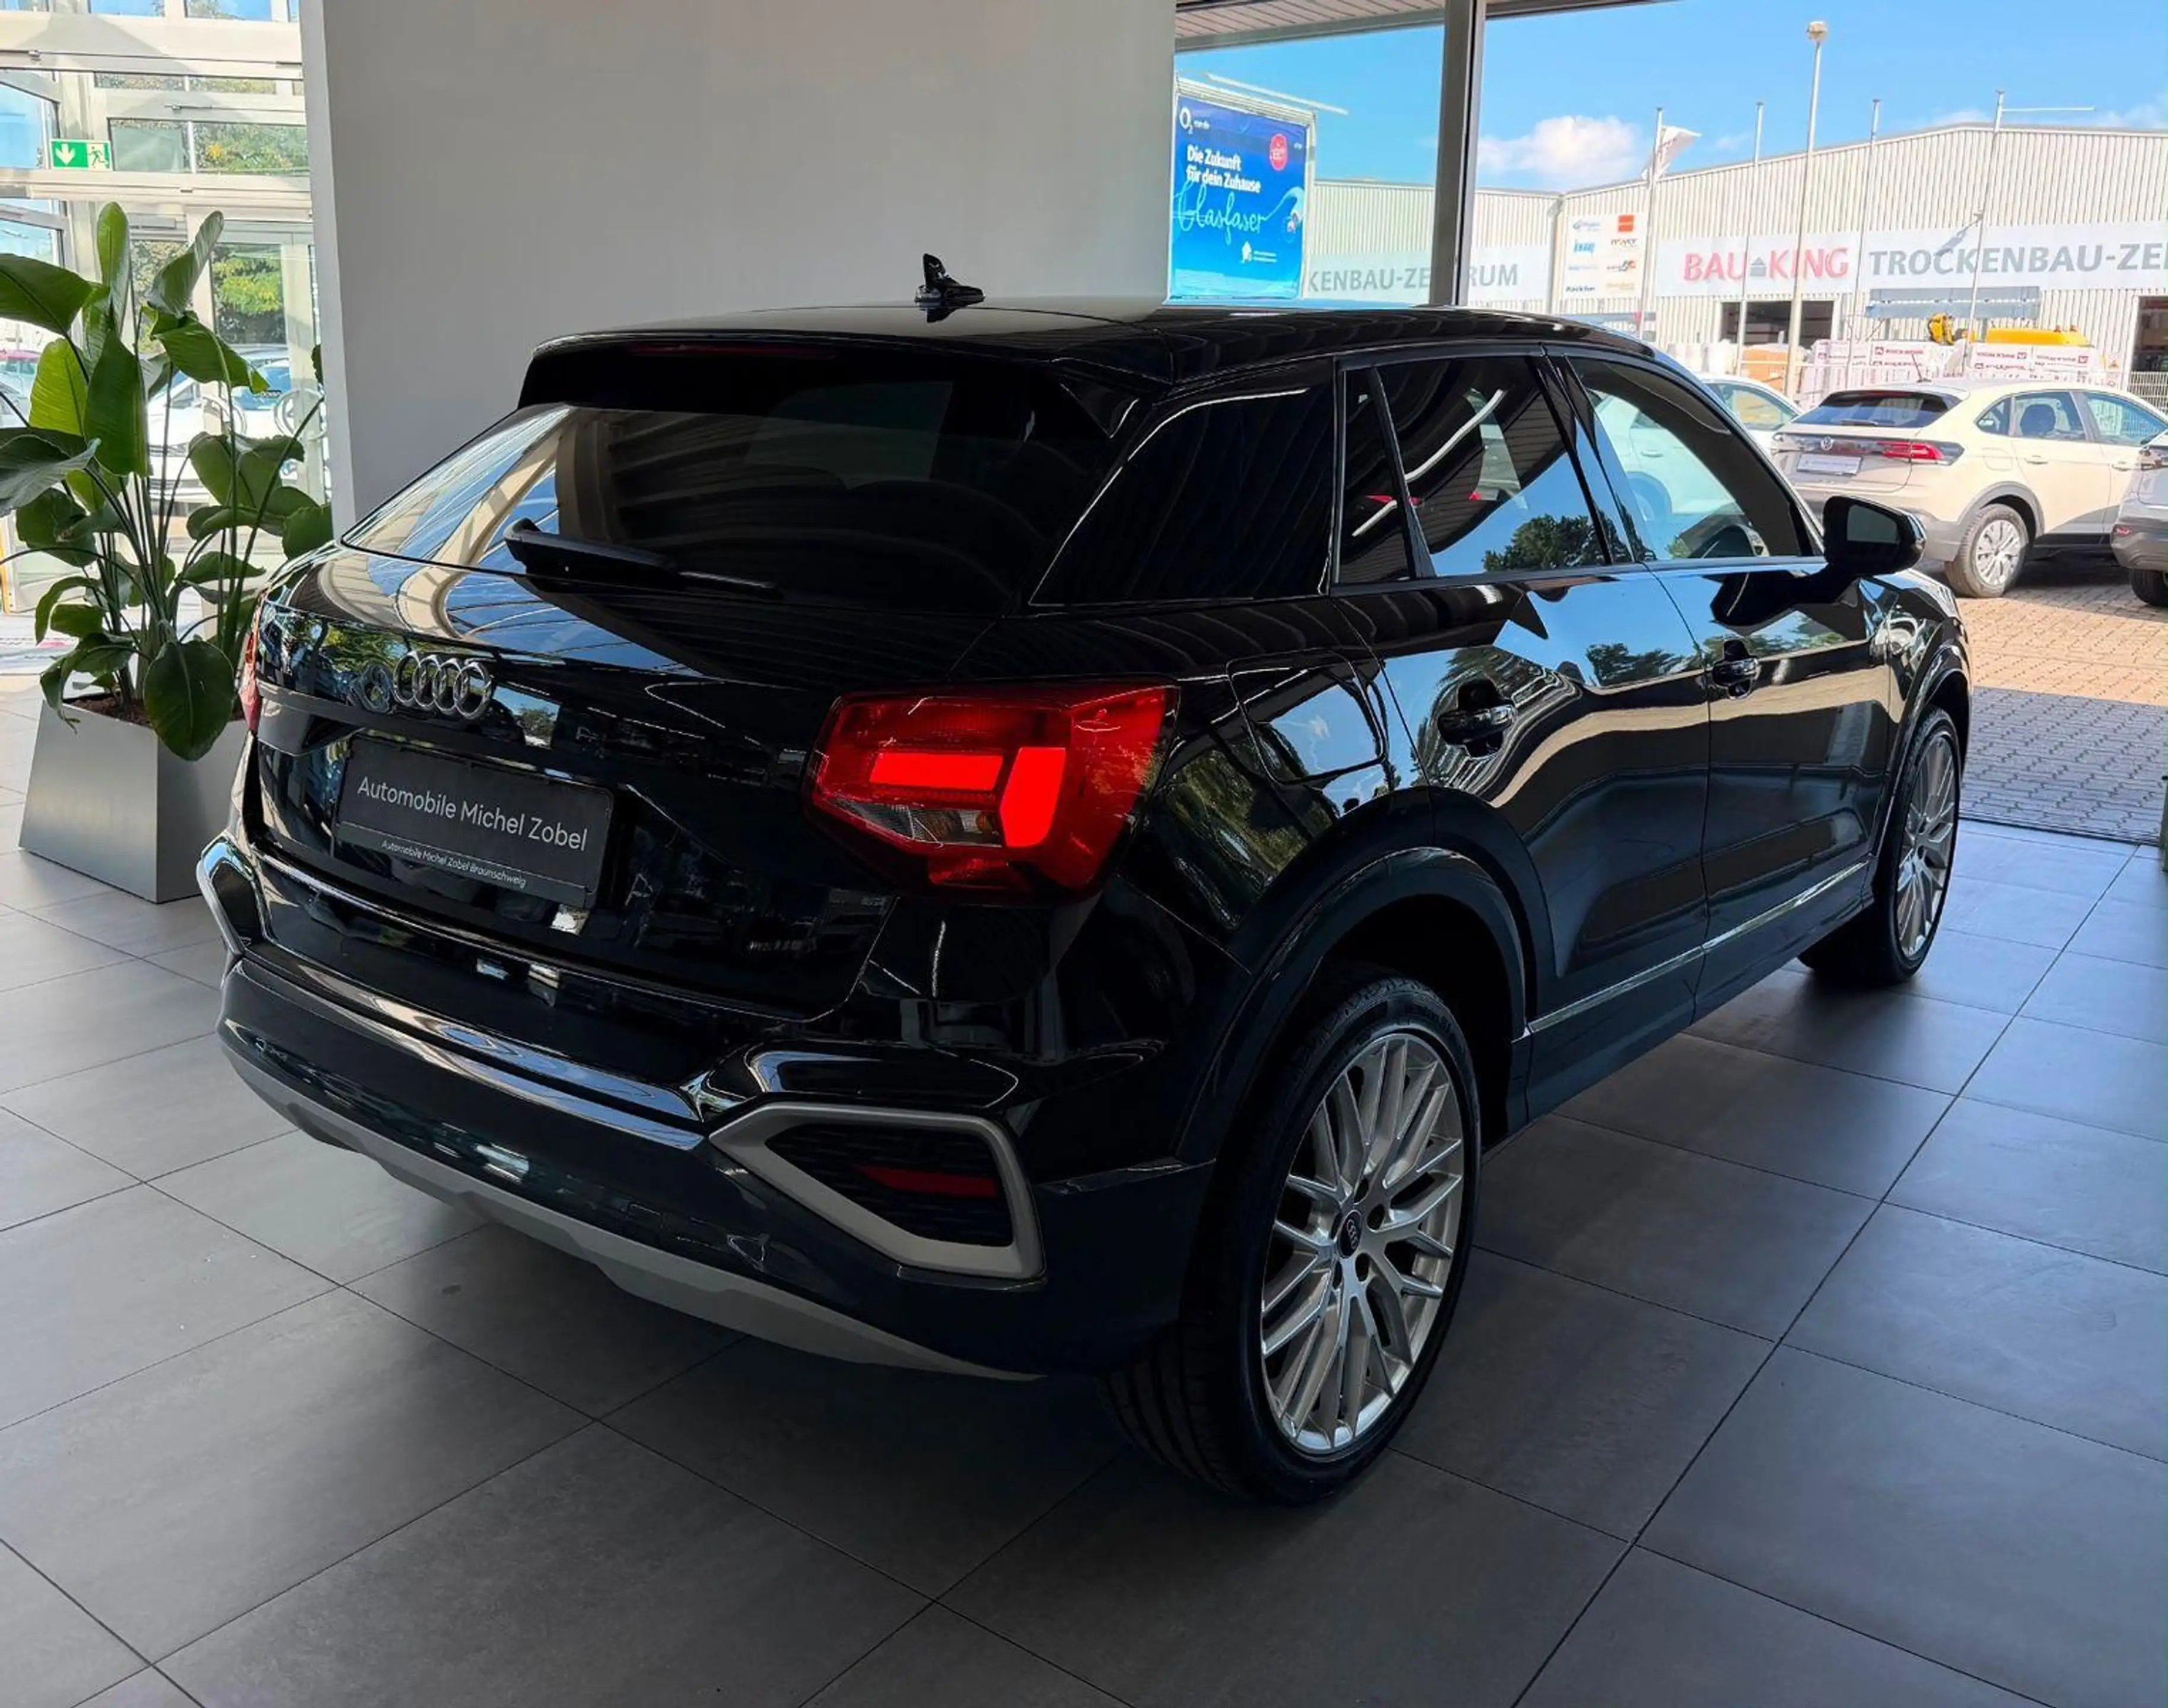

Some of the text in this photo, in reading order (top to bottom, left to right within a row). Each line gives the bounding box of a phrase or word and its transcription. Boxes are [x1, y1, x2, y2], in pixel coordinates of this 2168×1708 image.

[1188, 144, 1241, 171] Die Zukunft
[1202, 168, 1223, 187] dein
[1224, 172, 1261, 193] Zuhause
[1683, 247, 1849, 281] BAU KING
[1868, 242, 2168, 276] TROCKENBAU-ZE
[357, 776, 588, 852] Automobile Michel Zobel
[381, 840, 527, 890] Automobile Michel Zobel Braunschweig
